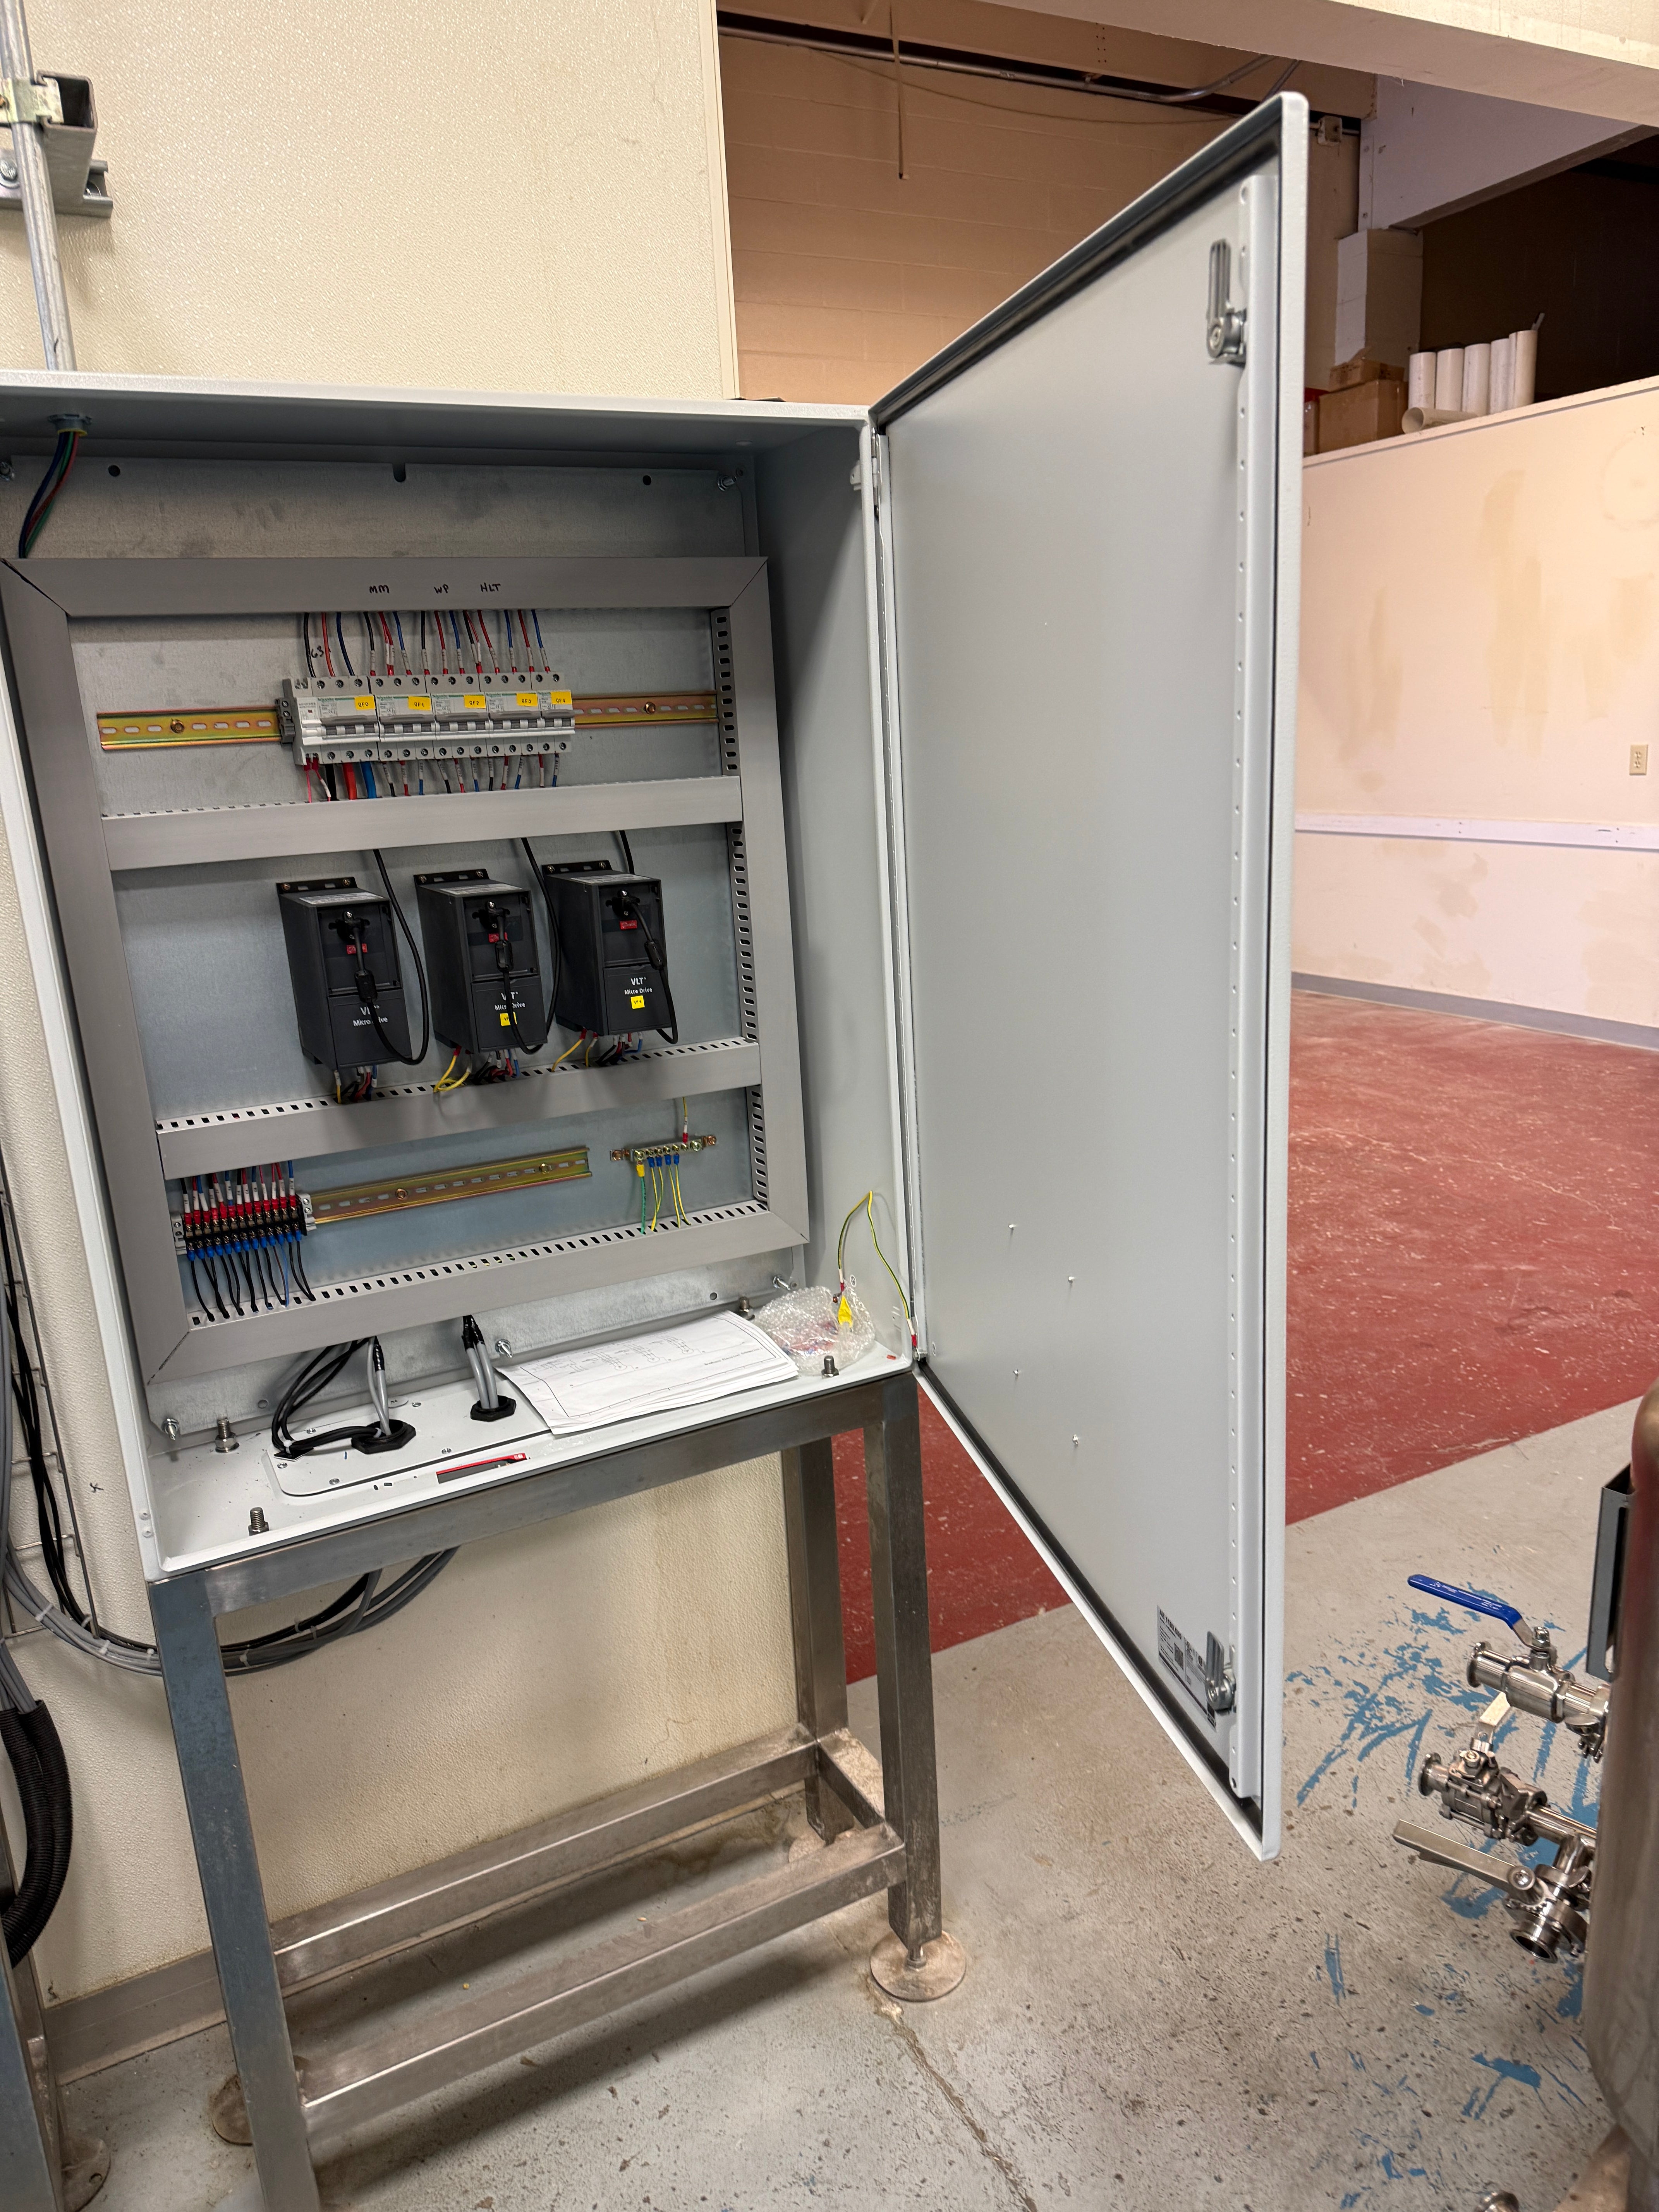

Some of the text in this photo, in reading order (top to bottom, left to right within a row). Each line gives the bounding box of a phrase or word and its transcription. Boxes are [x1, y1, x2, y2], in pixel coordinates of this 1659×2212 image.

[369, 584, 390, 594] MM
[433, 583, 449, 594] WP
[480, 582, 501, 592] HLT
[311, 645, 331, 658] 63
[501, 992, 515, 1001] VT
